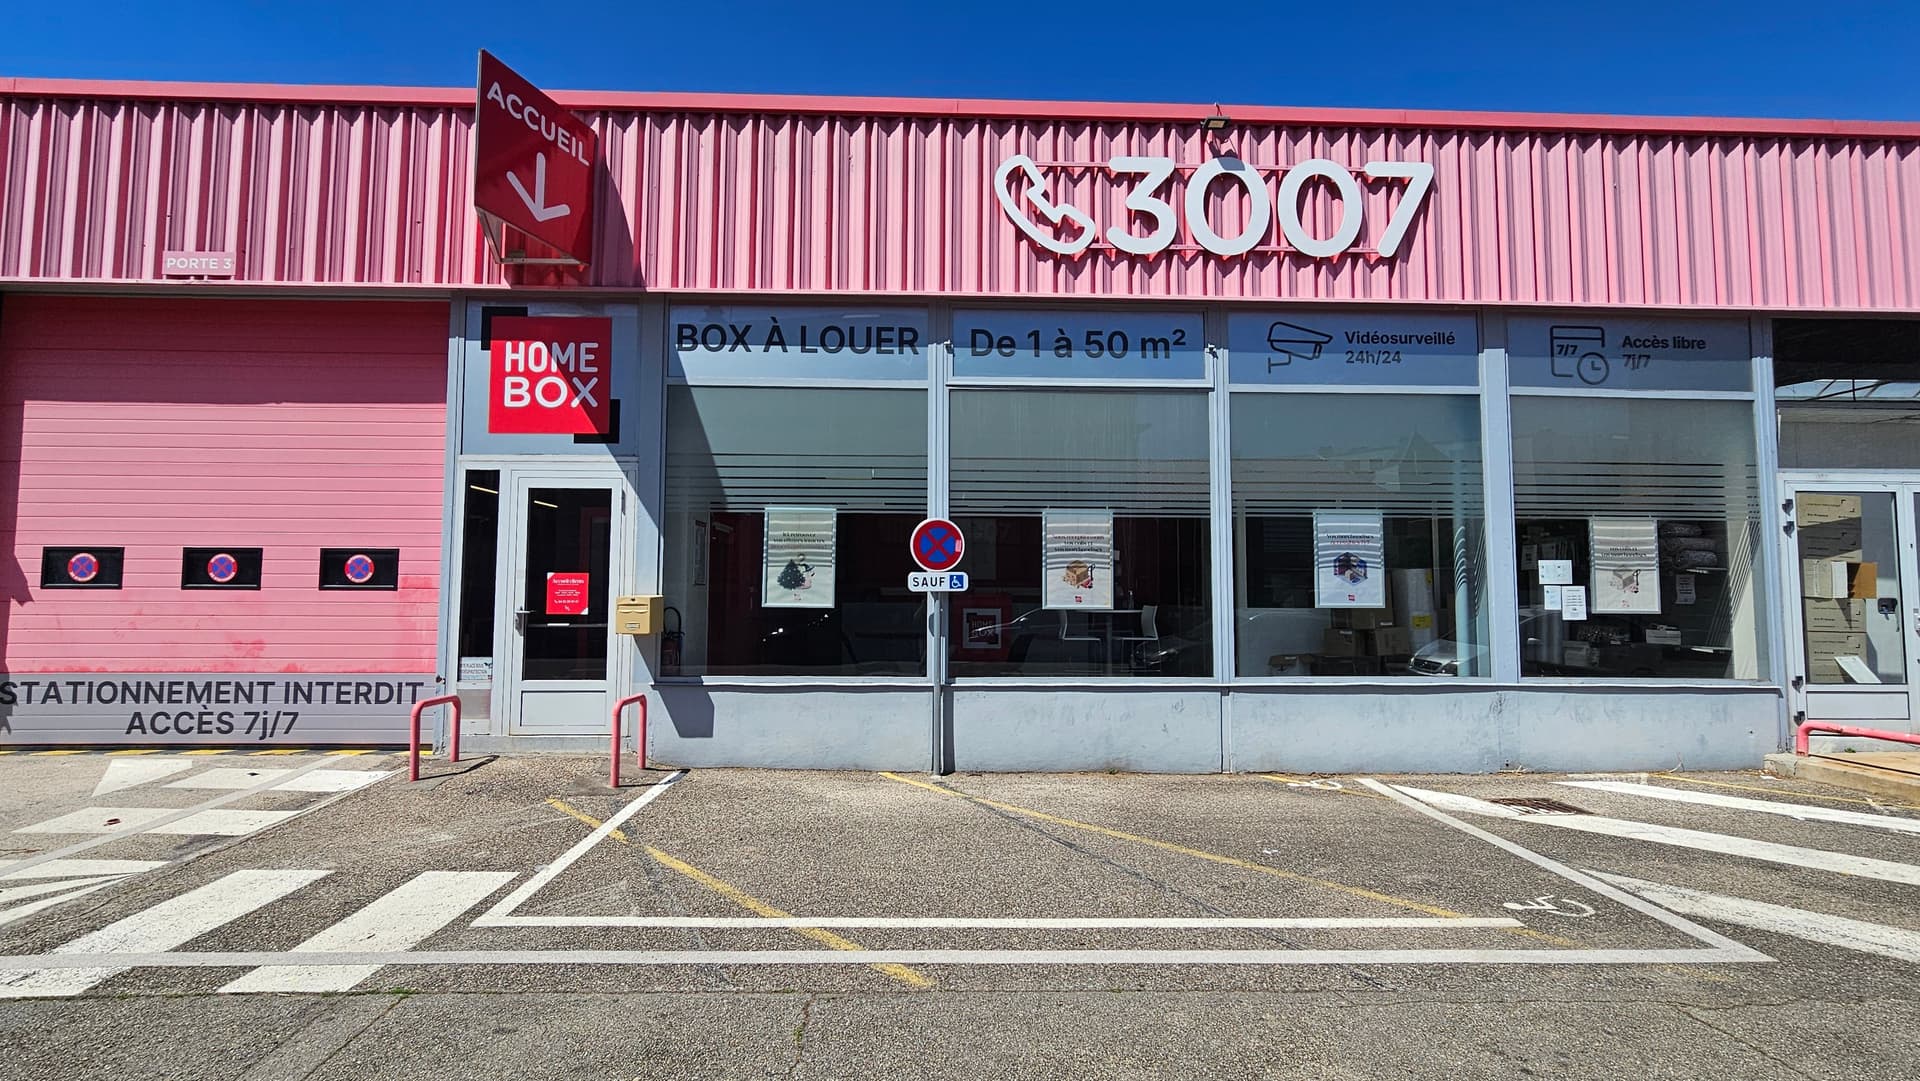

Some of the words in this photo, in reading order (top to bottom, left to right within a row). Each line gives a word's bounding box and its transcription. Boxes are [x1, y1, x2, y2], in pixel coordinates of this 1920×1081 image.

[486, 81, 590, 167] ACCUEIL
[1106, 156, 1435, 258] 3007
[166, 257, 219, 270] PORTE
[223, 257, 232, 269] 3
[676, 323, 753, 353] BOX
[762, 316, 789, 354] À
[800, 324, 920, 355] LOUER
[970, 328, 1017, 358] De
[1026, 329, 1041, 358] 1
[1053, 328, 1073, 359] à
[1084, 330, 1130, 360] 50
[1139, 328, 1187, 360] m²
[1344, 329, 1456, 347] Vidéosurveillé
[1622, 335, 1670, 350] Accès
[1672, 335, 1707, 350] libre
[503, 340, 599, 374] HOME
[1344, 349, 1403, 365] 24h/24
[1556, 344, 1578, 356] 7/7
[1622, 354, 1651, 370] 7j/7
[502, 376, 599, 409] BOX
[912, 576, 946, 587] SAUF
[0, 680, 276, 705] STATIONNEMENT
[283, 681, 425, 705] INTERDIT
[125, 705, 235, 735] ACCÈS
[243, 709, 299, 741] 7j/7
